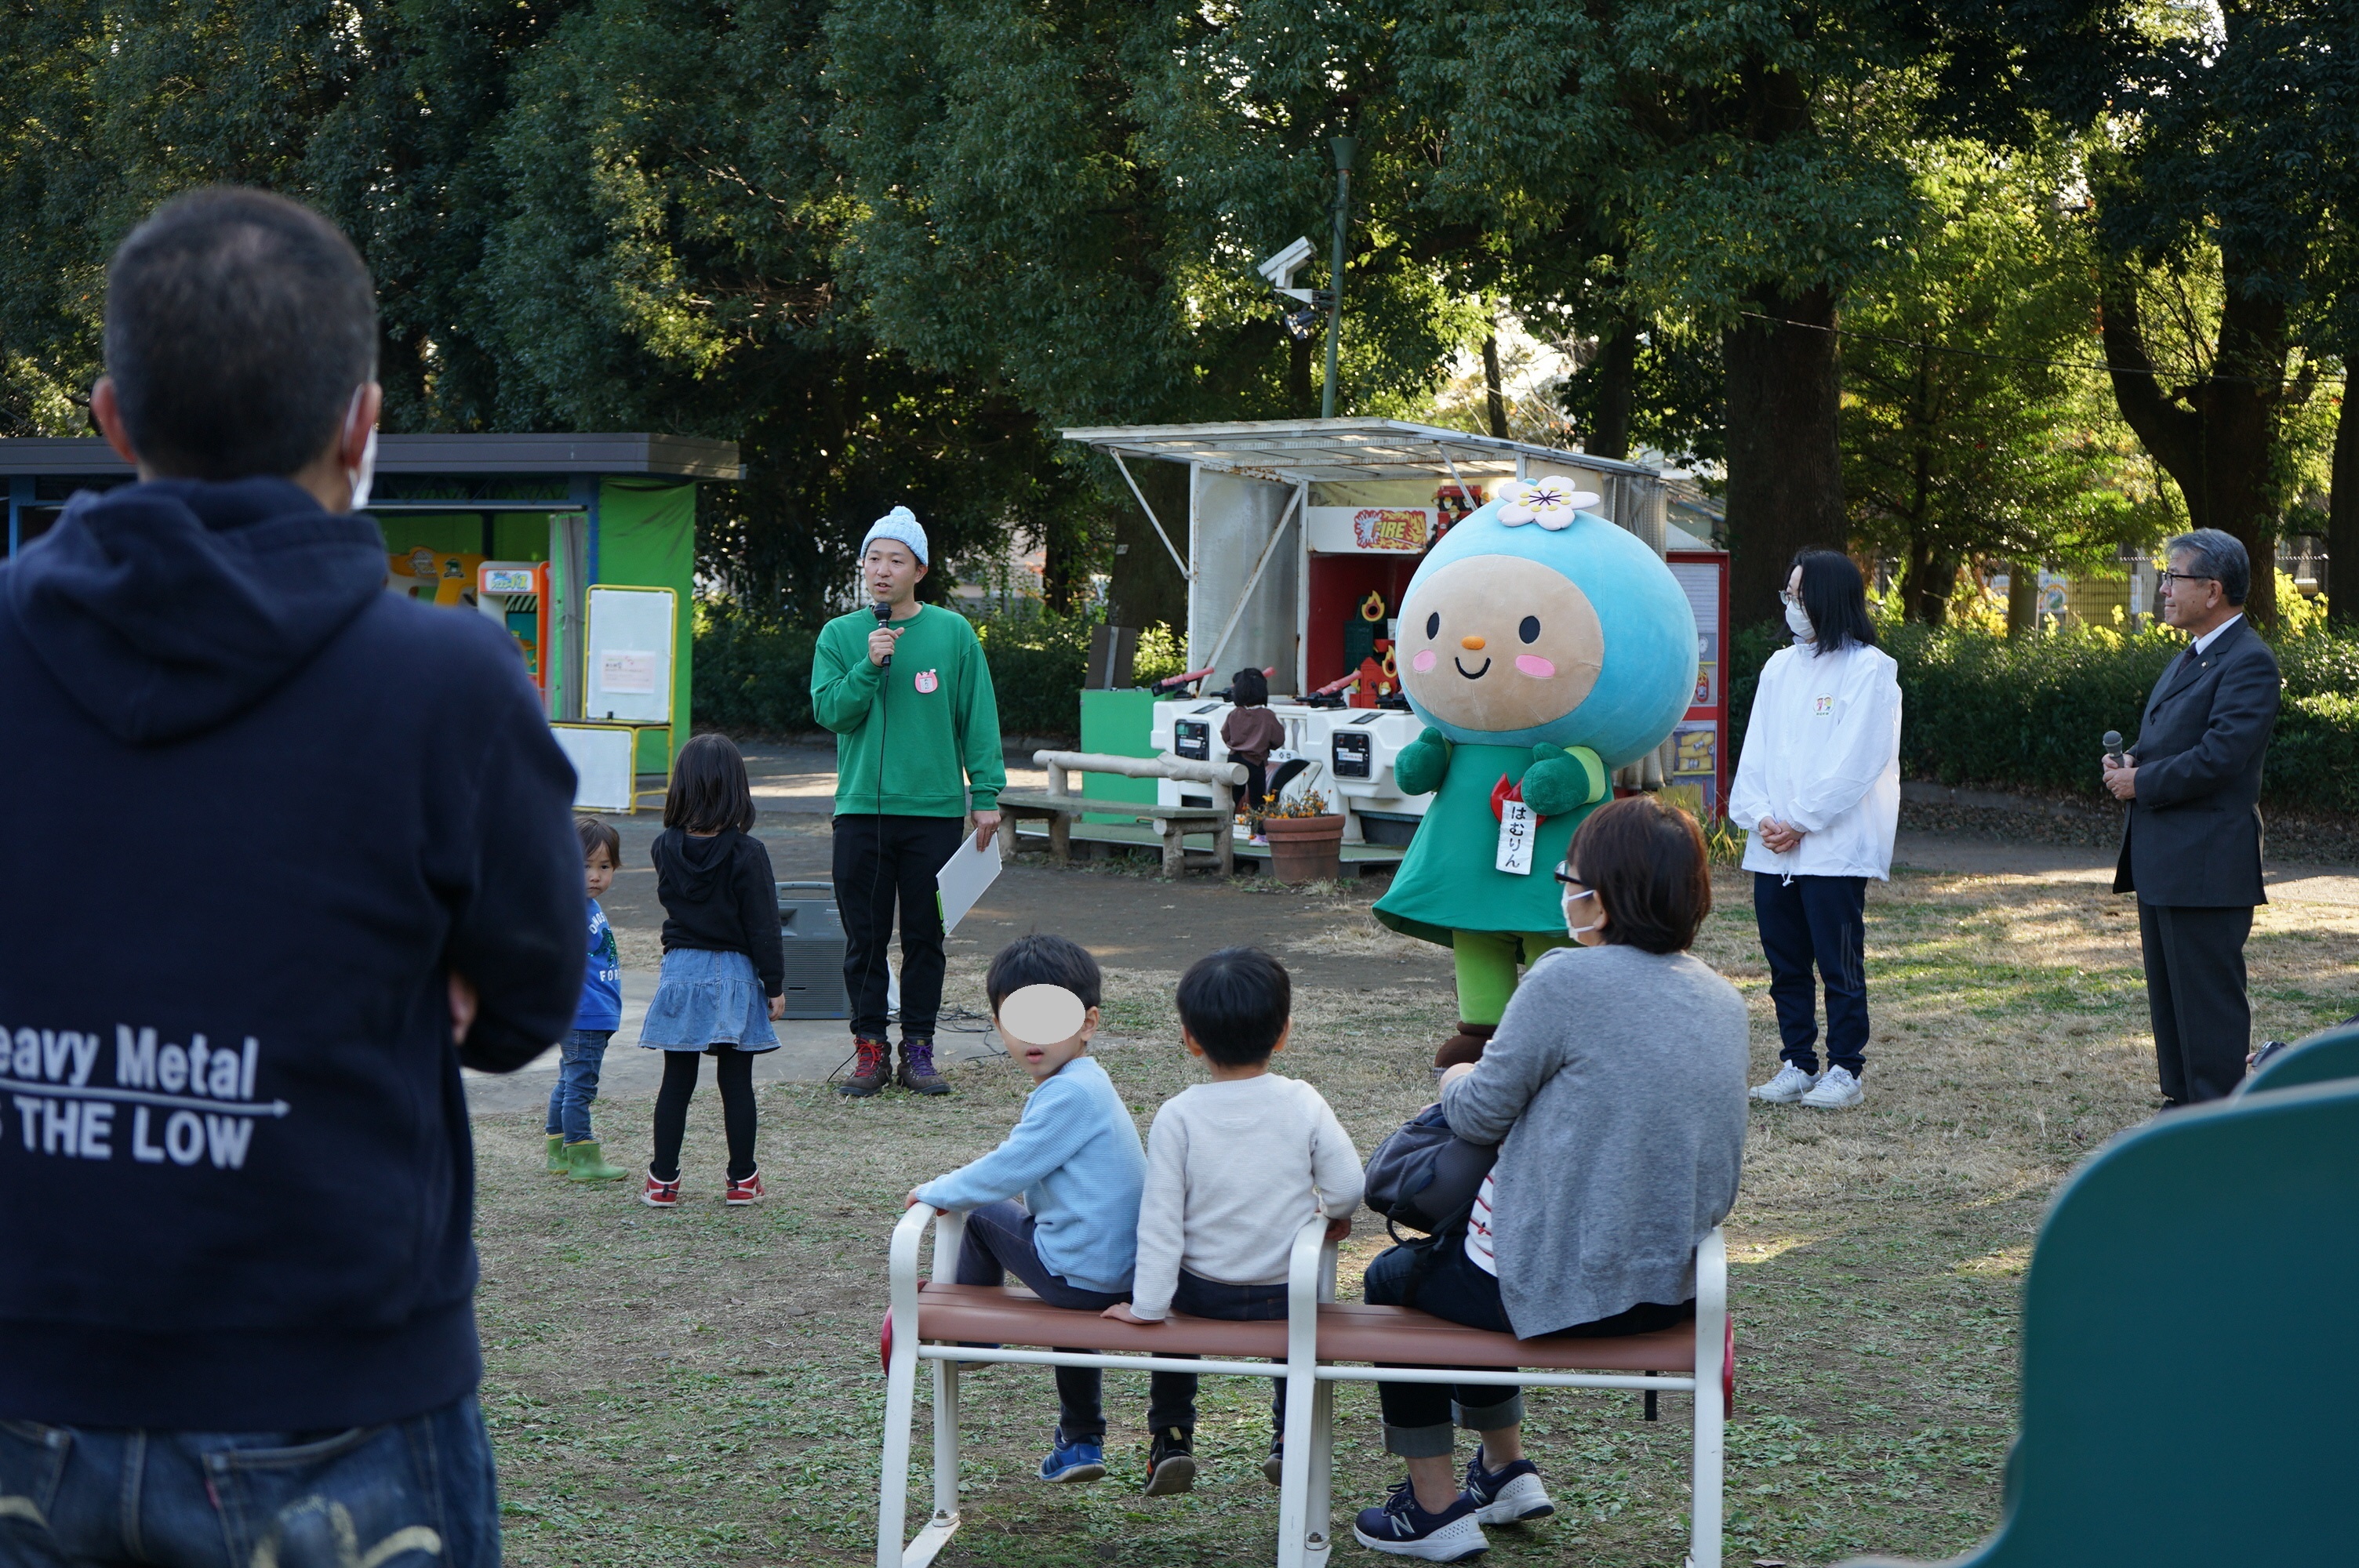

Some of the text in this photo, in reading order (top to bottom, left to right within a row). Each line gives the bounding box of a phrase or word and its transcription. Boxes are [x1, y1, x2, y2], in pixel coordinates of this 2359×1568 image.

[1371, 521, 1407, 539] FIRE
[1505, 806, 1527, 869] はむりん
[116, 1023, 259, 1101] Metal
[13, 1094, 115, 1161] THE
[133, 1105, 253, 1170] LOW
[1390, 1512, 1416, 1537] N
